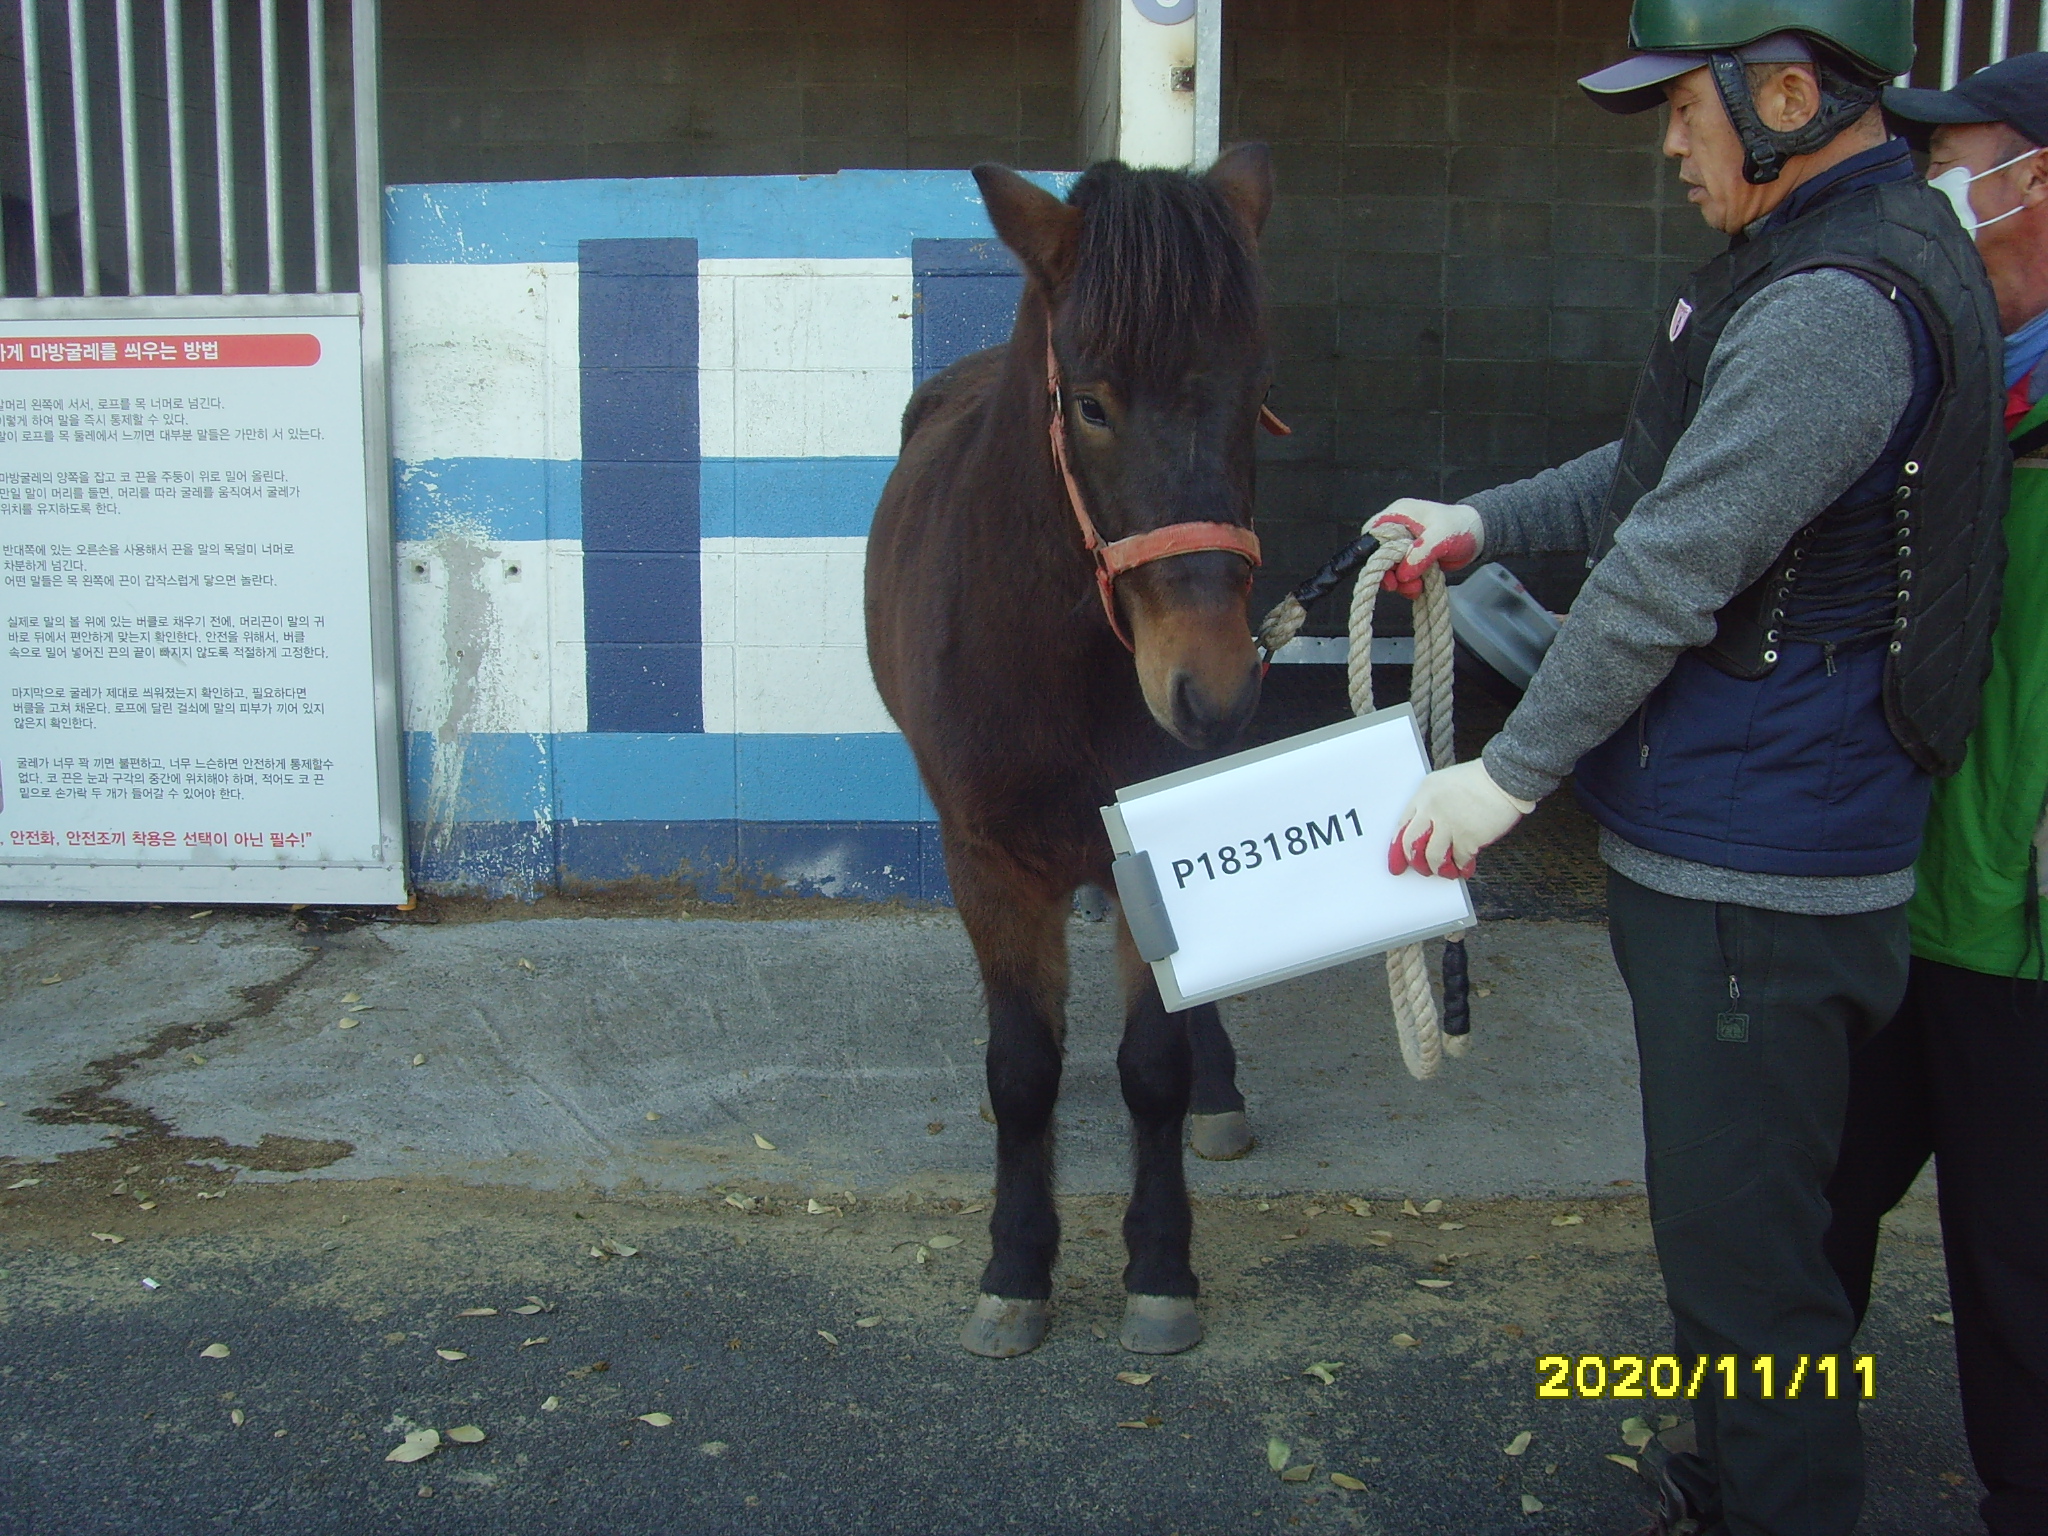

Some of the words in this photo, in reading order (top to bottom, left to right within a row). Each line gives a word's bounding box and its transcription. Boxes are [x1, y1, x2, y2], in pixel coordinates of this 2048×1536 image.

[30, 342, 118, 362] 마방굴레를
[124, 342, 178, 361] 씌우는
[183, 341, 219, 360] 방법
[30, 398, 64, 412] 왼쪽에
[97, 397, 131, 411] 로프를
[134, 397, 147, 411] 목
[150, 397, 185, 411] 너머로
[187, 396, 225, 410] 넘긴다.
[31, 414, 54, 427] 하여
[57, 413, 81, 427] 말을
[83, 413, 106, 427] 즉시
[109, 413, 144, 427] 통제할
[147, 413, 160, 426] 수
[162, 412, 189, 426] 있다.
[21, 429, 55, 443] 로프를
[58, 429, 70, 443] 목
[73, 429, 118, 443] 둘레에서
[122, 429, 155, 442] 느끼면
[159, 428, 194, 442] 대부분
[196, 428, 231, 442] 말들은
[234, 427, 268, 441] 가만히
[272, 427, 283, 441] 서
[287, 427, 325, 441] 있는다.
[0, 471, 53, 485] 마방굴레의
[56, 471, 91, 485] 양쪽을
[93, 471, 117, 484] 잡고
[119, 471, 132, 483] 코
[134, 470, 158, 484] 끈을
[161, 470, 195, 484] 주둥이
[198, 470, 222, 483] 위로
[225, 470, 247, 483] 밀어
[251, 469, 289, 483] 올린다.
[0, 487, 22, 500] 만일
[24, 487, 47, 500] 말이
[51, 487, 85, 500] 머리를
[117, 486, 151, 500] 머리를
[154, 486, 177, 499] 따라
[180, 486, 215, 499] 굴레를
[217, 485, 263, 499] 움직여서
[266, 485, 301, 499] 굴레가
[0, 502, 34, 516] 위치를
[36, 502, 92, 516] 유지하도록
[95, 502, 121, 515] 한다.
[2, 543, 47, 557] 반대쪽에
[49, 543, 73, 557] 있는
[75, 543, 120, 557] 오른손을
[123, 543, 168, 557] 사용해서
[171, 542, 195, 556] 끈을
[197, 543, 220, 556] 말의
[223, 542, 257, 556] 목덜미
[261, 542, 295, 556] 너머로
[3, 559, 47, 572] 차분하게
[51, 559, 88, 572] 넘긴다.
[4, 574, 27, 588] 어떤
[30, 574, 64, 588] 말들은
[66, 574, 79, 587] 목
[81, 574, 115, 588] 왼쪽에
[118, 574, 141, 587] 끈이
[144, 574, 200, 587] 갑작스럽게
[203, 574, 237, 588] 닿으면
[240, 574, 278, 587] 놀란다.
[7, 615, 40, 629] 실제로
[43, 615, 66, 629] 말의
[84, 615, 107, 628] 위에
[110, 615, 133, 628] 있는
[136, 615, 170, 628] 버클로
[172, 615, 206, 628] 채우기
[239, 615, 283, 628] 머리끈이
[287, 615, 310, 628] 말의
[313, 615, 325, 628] 귀
[8, 631, 31, 644] 바로
[34, 631, 67, 644] 뒤에서
[70, 630, 114, 644] 편안하게
[117, 630, 151, 644] 맞는지
[153, 630, 202, 644] 확인한다.
[205, 630, 239, 644] 안전을
[242, 630, 279, 644] 위해서,
[283, 630, 306, 644] 버클
[8, 646, 42, 659] 속으로
[45, 646, 67, 659] 밀어
[71, 646, 104, 659] 넣어진
[107, 646, 130, 659] 끈의
[132, 646, 156, 659] 끝이
[159, 646, 193, 660] 빠지지
[195, 646, 230, 659] 않도록
[233, 645, 277, 659] 적절하게
[280, 645, 329, 659] 고정한다.
[11, 686, 67, 700] 마지막으로
[68, 686, 103, 700] 굴레가
[105, 686, 140, 700] 제대로
[142, 686, 198, 700] 씌워졌는지
[200, 686, 249, 700] 확인하고,
[251, 686, 307, 700] 필요하다면
[13, 701, 46, 715] 버클을
[48, 701, 71, 715] 고쳐
[74, 701, 111, 715] 채운다.
[114, 702, 147, 715] 로프에
[150, 702, 173, 715] 달린
[177, 702, 210, 715] 걸쇠에
[213, 702, 236, 715] 말의
[239, 702, 273, 715] 피부가
[276, 702, 298, 715] 끼어
[302, 702, 325, 715] 있지
[13, 716, 47, 730] 않은지
[49, 716, 97, 730] 확인한다.
[16, 756, 50, 770] 굴레가
[53, 756, 75, 770] 너무
[77, 757, 90, 770] 꽉
[93, 757, 115, 770] 끼면
[118, 757, 166, 771] 불편하고,
[169, 757, 192, 770] 너무
[194, 757, 239, 771] 느슨하면
[242, 757, 286, 771] 안전하게
[289, 757, 335, 771] 통제할수
[17, 771, 43, 785] 없다.
[46, 772, 59, 783] 코
[61, 771, 84, 785] 끈은
[86, 772, 109, 785] 눈과
[111, 772, 145, 786] 구각의
[148, 772, 182, 785] 중간에
[185, 772, 229, 786] 위치해야
[261, 773, 295, 786] 적어도
[298, 774, 310, 785] 코
[313, 773, 325, 786] 끈
[19, 786, 52, 800] 밑으로
[54, 786, 88, 800] 손가락
[90, 787, 103, 800] 두
[106, 787, 128, 800] 개가
[131, 787, 165, 800] 들어갈
[167, 787, 180, 800] 수
[182, 787, 216, 800] 있어야
[218, 787, 245, 801] 한다.
[9, 829, 60, 847] 안전화,
[65, 829, 126, 847] 안전조끼
[131, 830, 178, 848] 착용은
[182, 831, 228, 848] 선택이
[233, 831, 264, 848] 아닌
[269, 831, 313, 848] 필수!”
[1172, 808, 1364, 889] P18318M1
